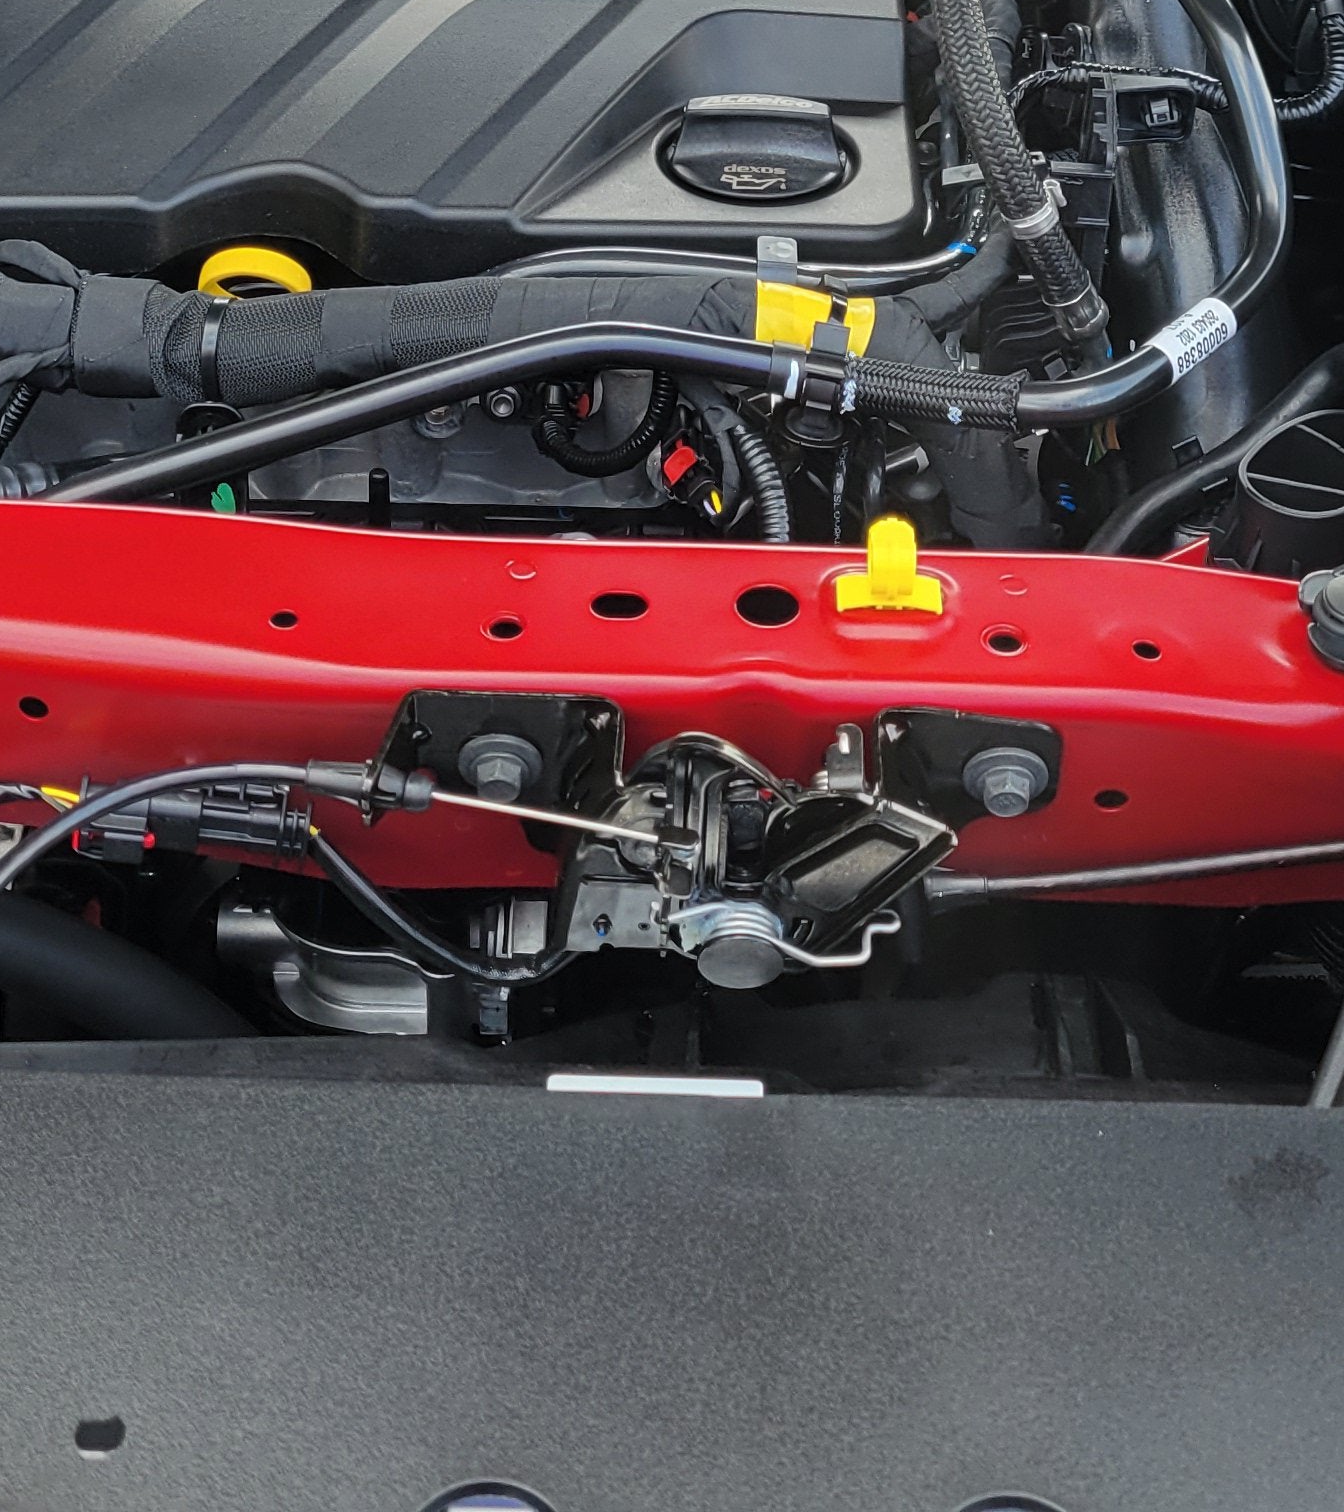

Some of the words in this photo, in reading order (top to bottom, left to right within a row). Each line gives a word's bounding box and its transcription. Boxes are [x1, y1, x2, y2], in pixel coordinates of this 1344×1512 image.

[703, 96, 814, 109] ACDelco
[723, 163, 787, 175] dexos
[1177, 322, 1228, 373] 60008388
